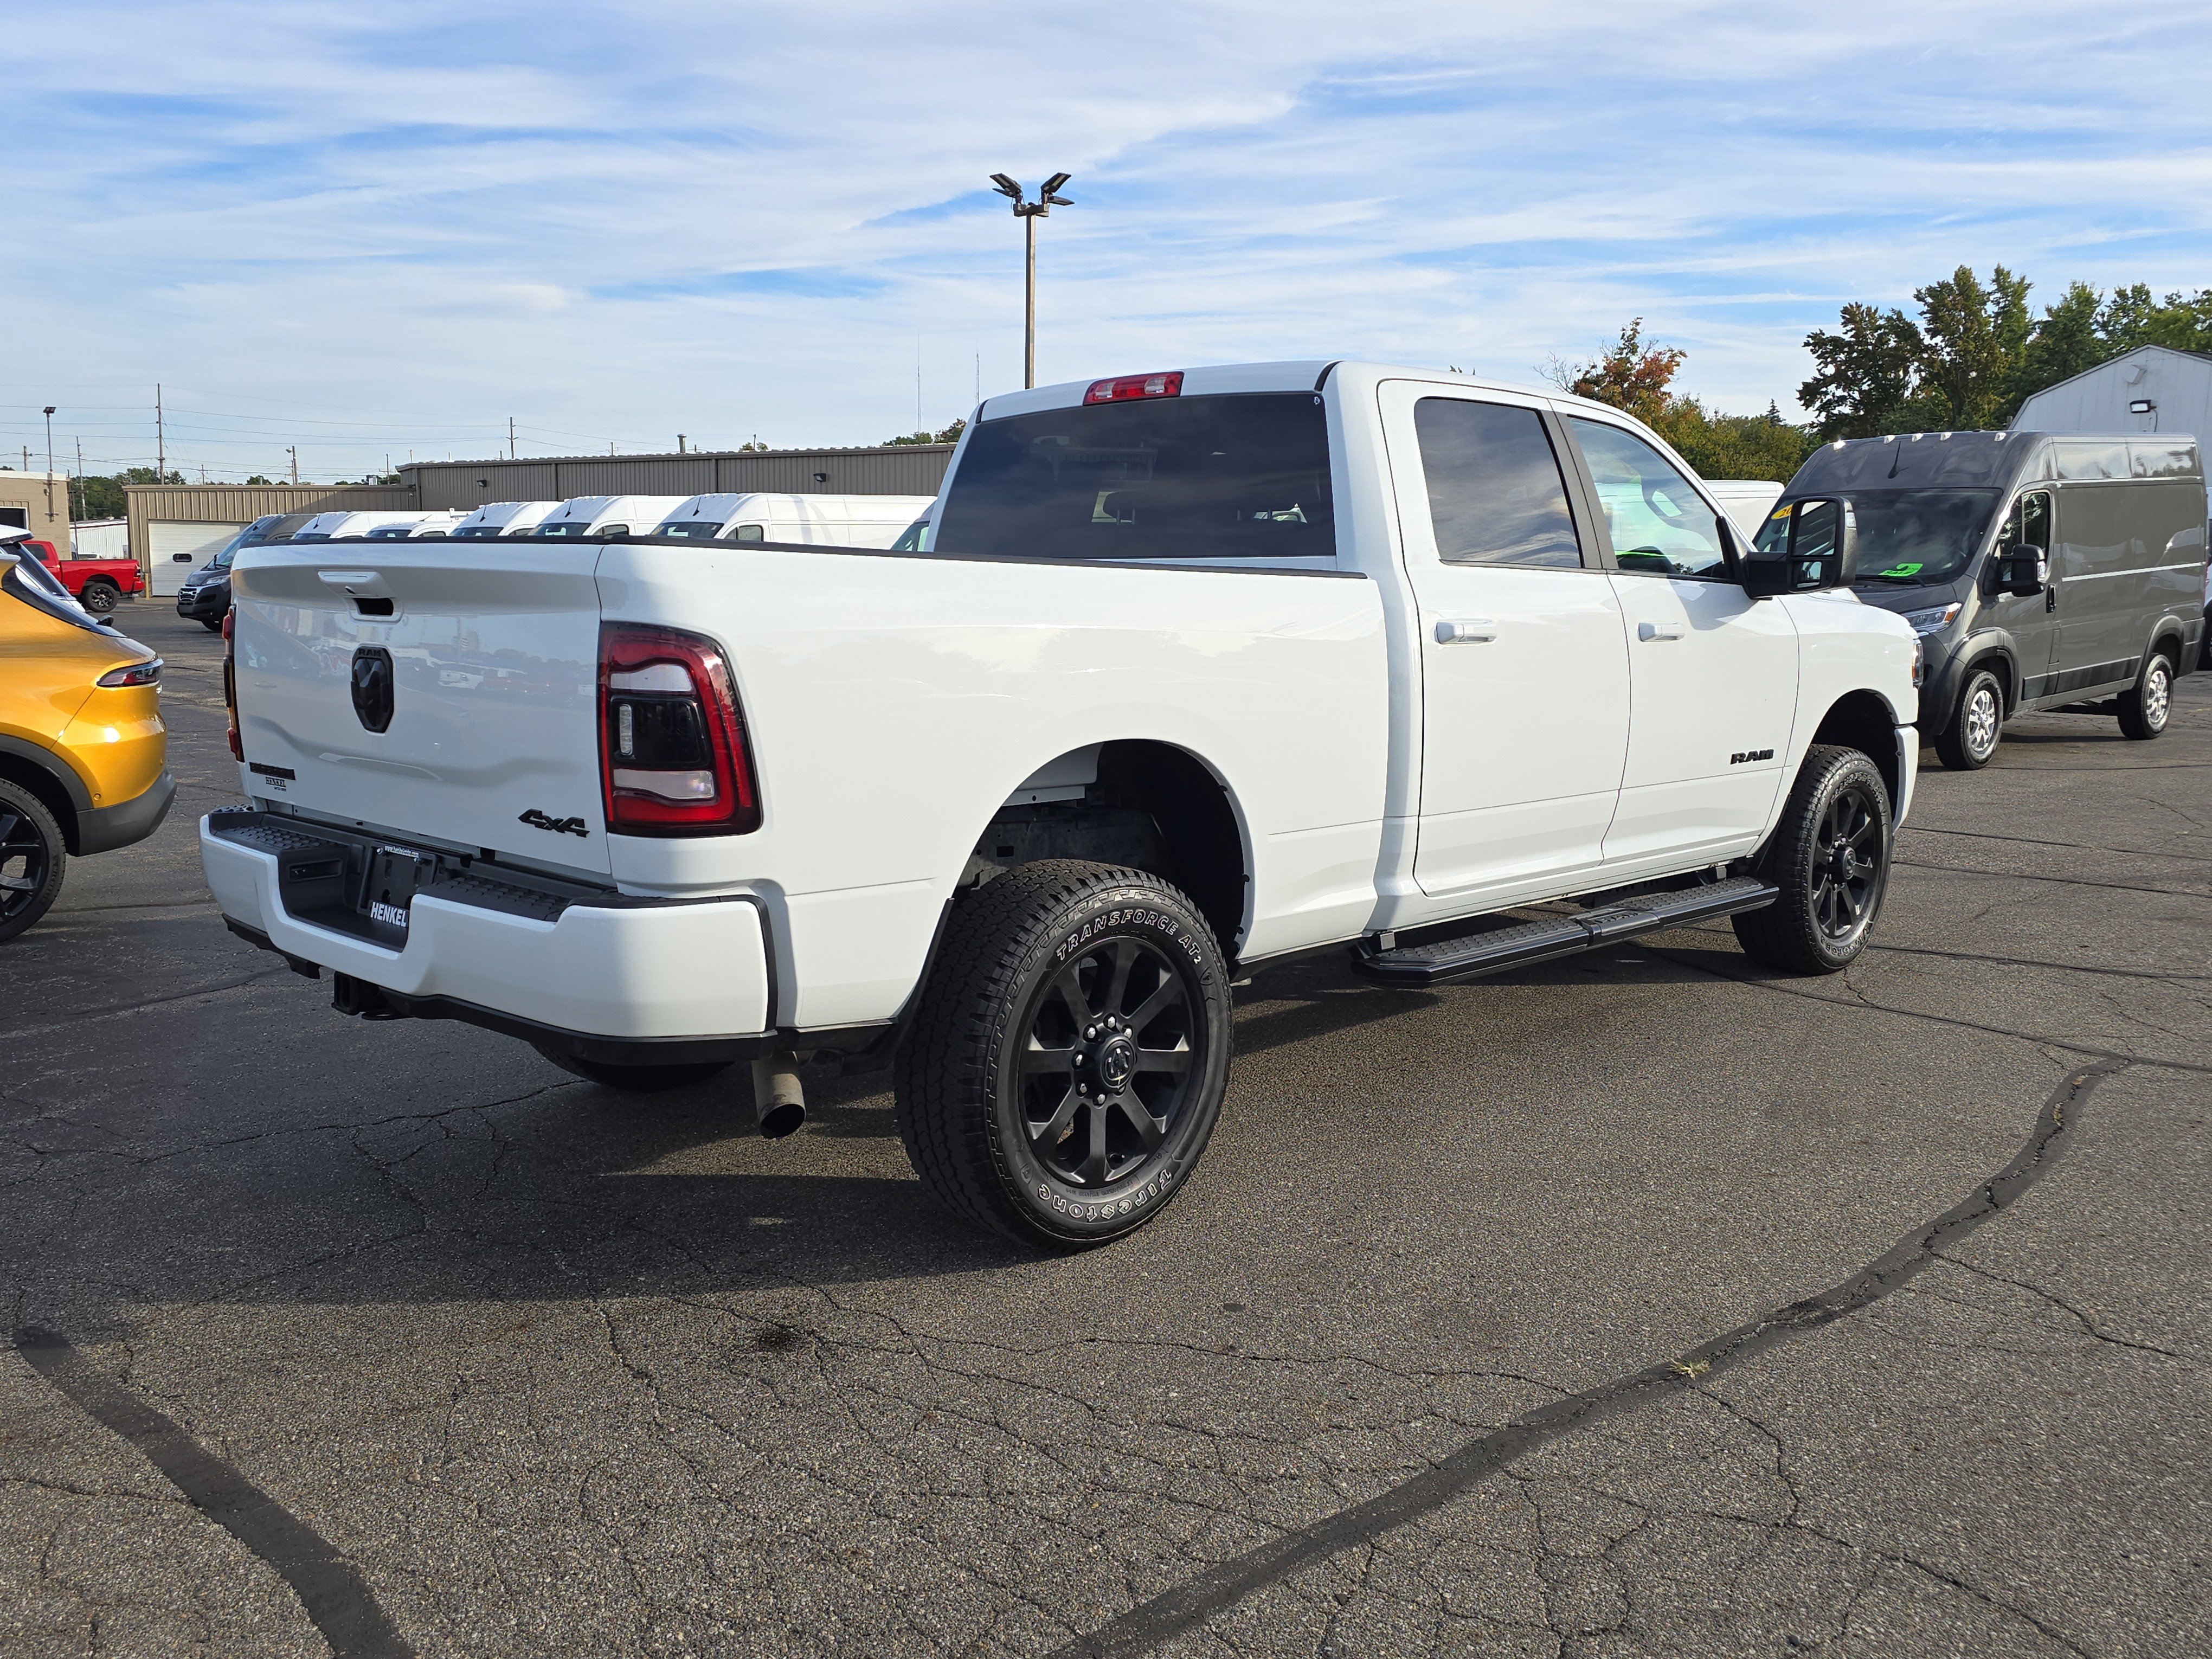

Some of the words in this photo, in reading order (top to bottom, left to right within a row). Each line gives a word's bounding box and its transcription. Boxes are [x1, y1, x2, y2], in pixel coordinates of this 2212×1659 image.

[358, 649, 382, 657] RAM
[1730, 749, 1774, 764] RAM
[370, 901, 407, 928] HENKEL
[1056, 909, 1180, 961] TRANSFORCE
